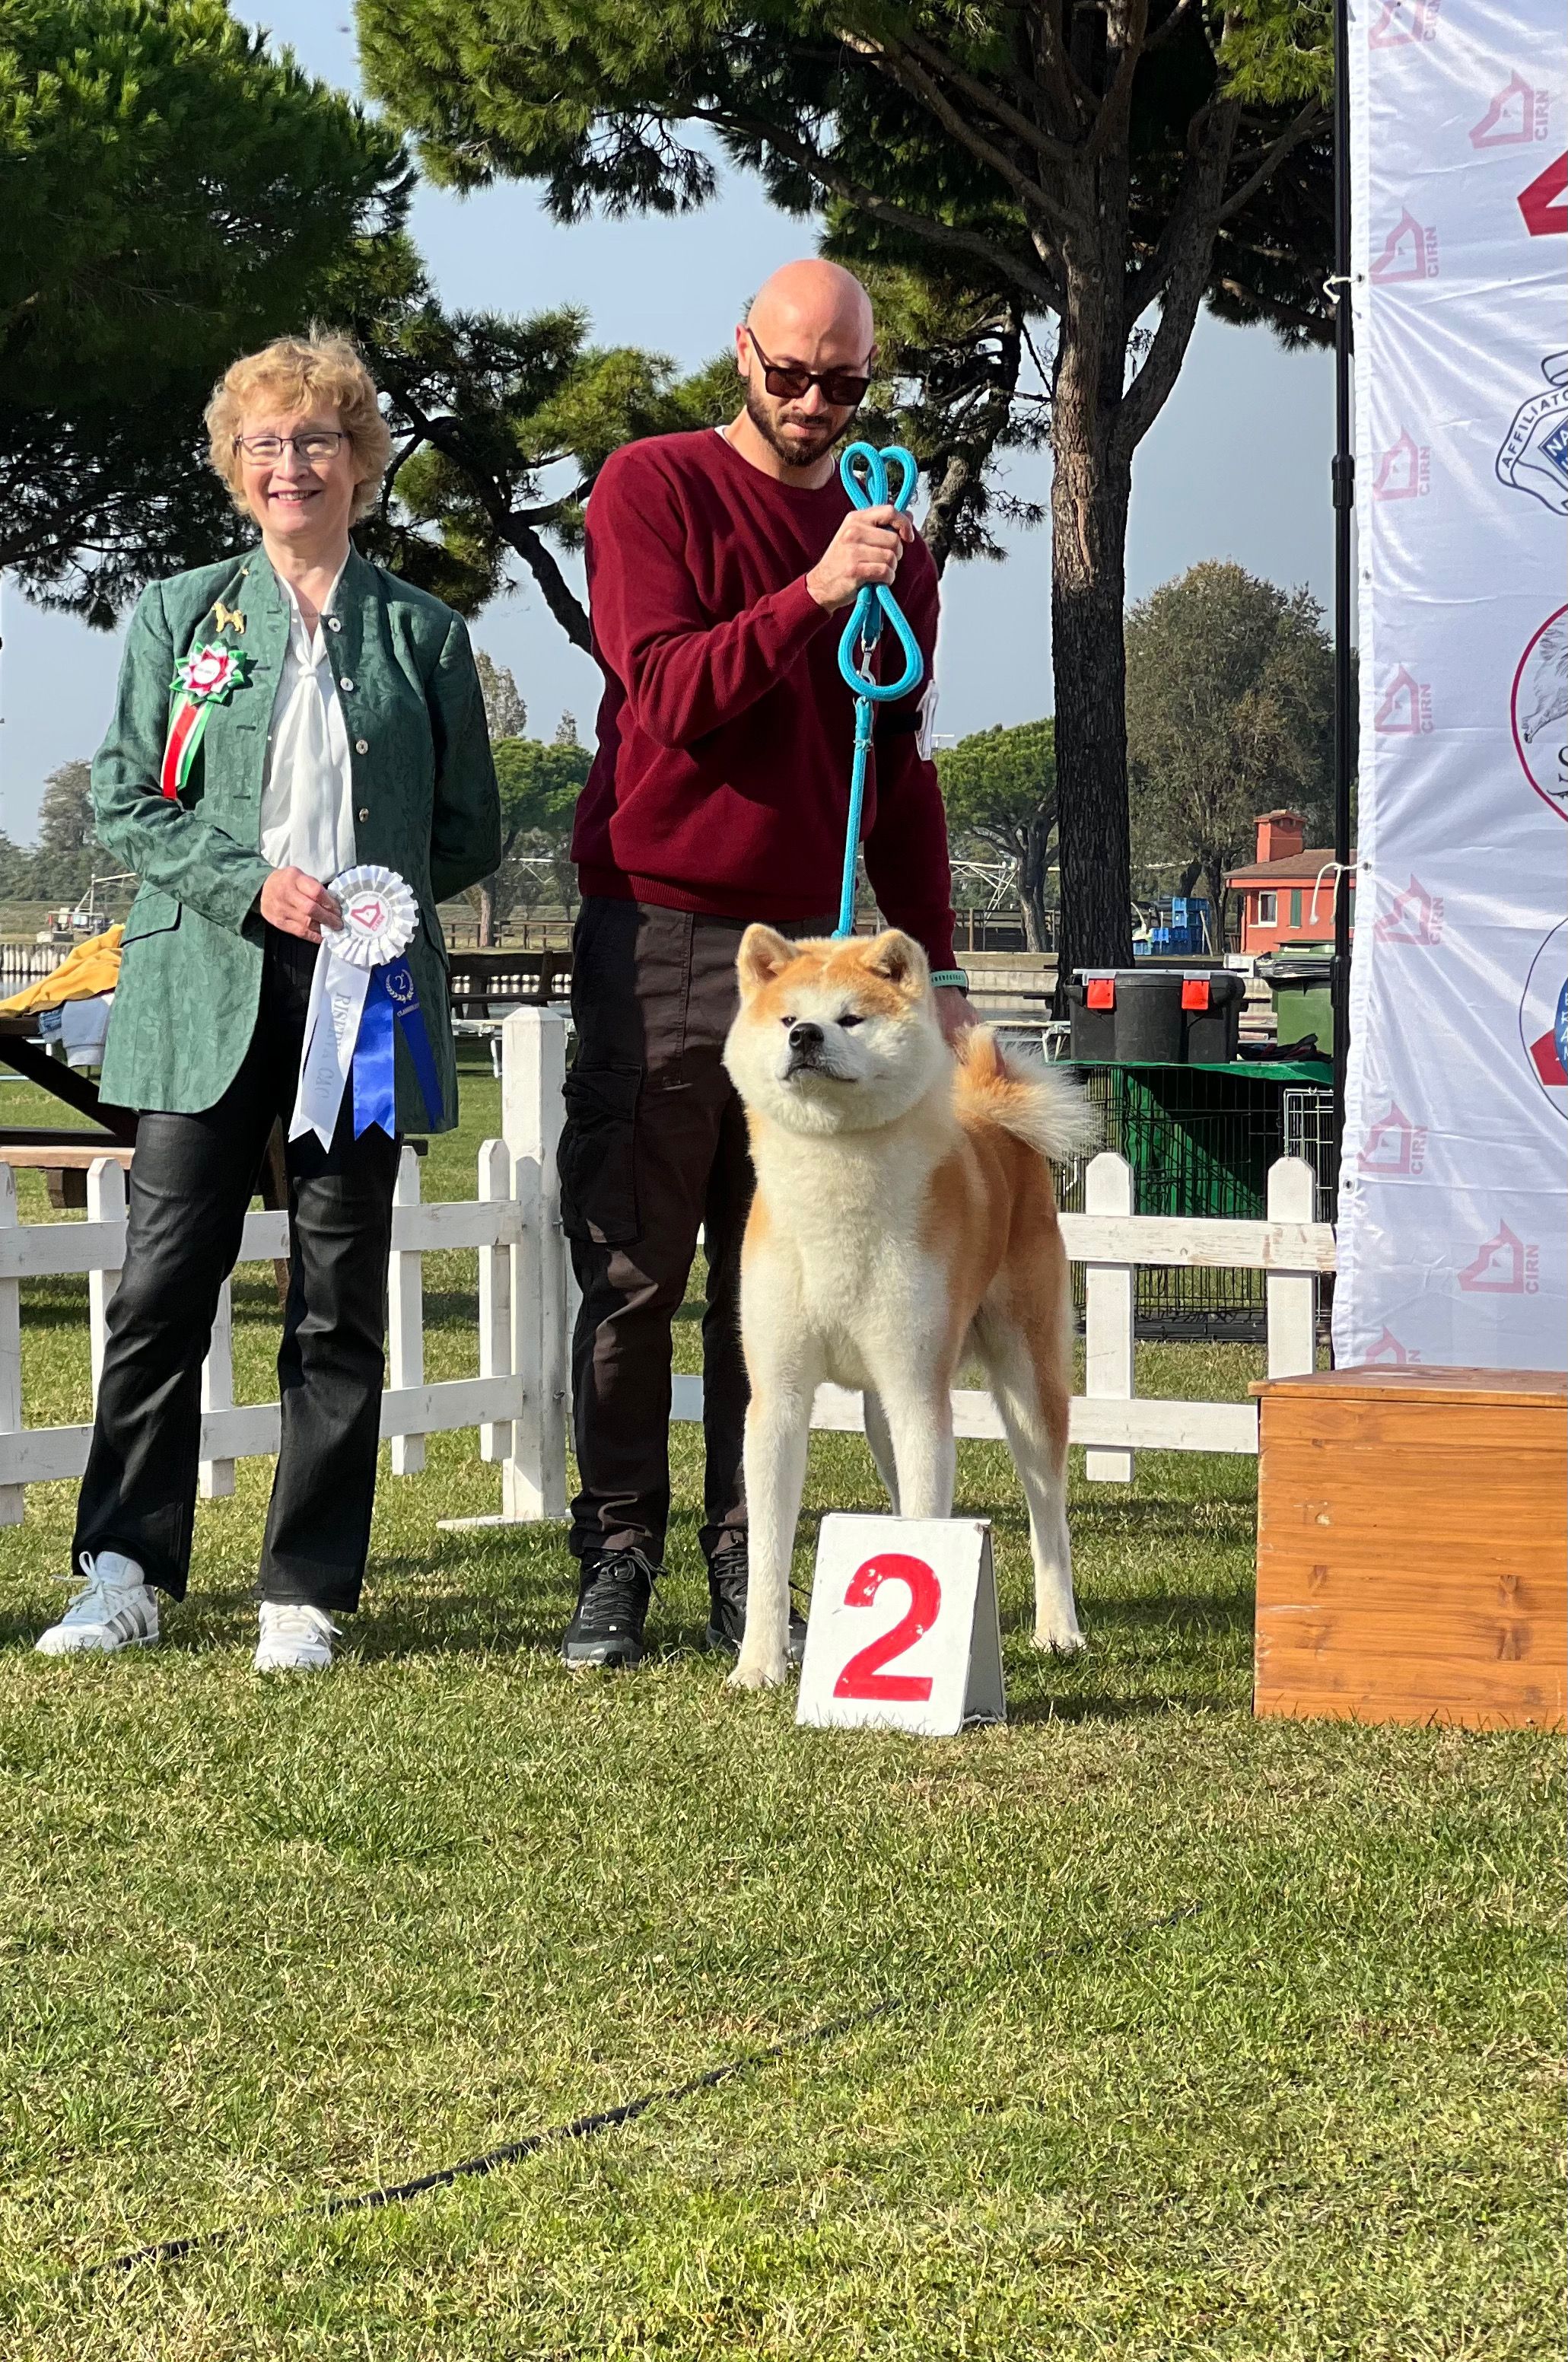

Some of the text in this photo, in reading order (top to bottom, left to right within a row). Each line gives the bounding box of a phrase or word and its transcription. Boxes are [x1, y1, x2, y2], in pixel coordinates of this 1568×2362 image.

[1535, 90, 1549, 142] CIRN
[1424, 226, 1439, 279] CIRN
[1419, 446, 1431, 496] CIRN
[1420, 683, 1434, 734] CIRN
[1429, 896, 1444, 945] CIRN
[1411, 1125, 1428, 1175] CIRN
[1525, 1244, 1539, 1294] CIRN
[833, 1553, 941, 1701] 2
